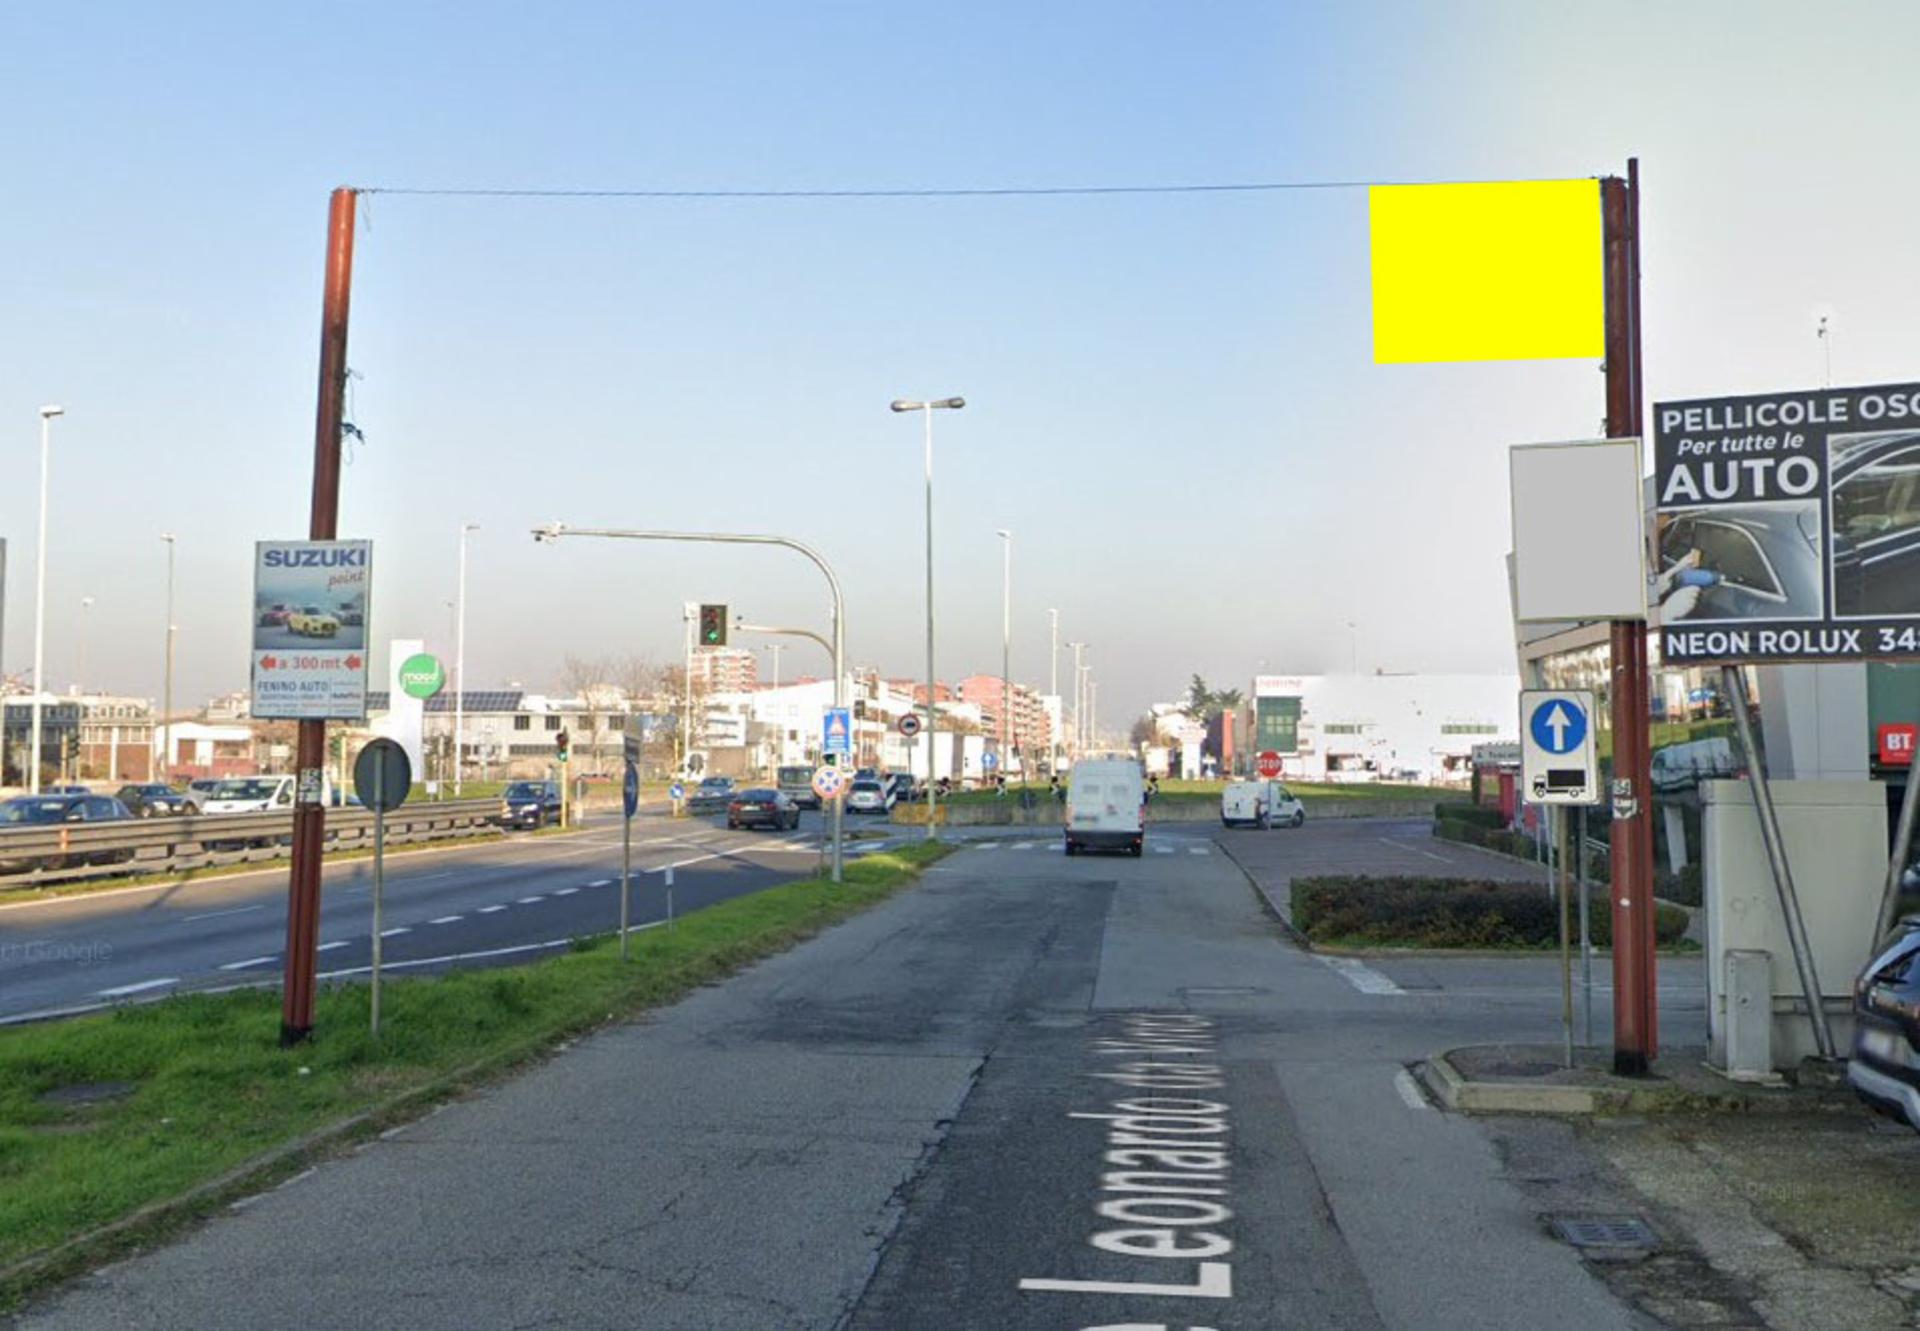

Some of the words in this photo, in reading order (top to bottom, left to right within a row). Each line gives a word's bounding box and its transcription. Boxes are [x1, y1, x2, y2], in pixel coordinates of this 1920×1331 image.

[1662, 397, 1849, 434] PELLICOLE
[1677, 438, 1717, 456] Per
[1721, 434, 1777, 453] tutte
[1783, 431, 1804, 451] le
[1662, 455, 1820, 503] AUTO
[264, 549, 365, 568] SUZUKI
[327, 570, 365, 591] point
[1666, 631, 1750, 657] NEON
[1759, 628, 1862, 655] ROLUX
[1878, 626, 1920, 652] 34
[291, 657, 319, 670] 300
[320, 657, 341, 670] mt
[257, 680, 297, 693] FENINO
[300, 680, 329, 692] AUTO
[1256, 759, 1282, 769] STOP
